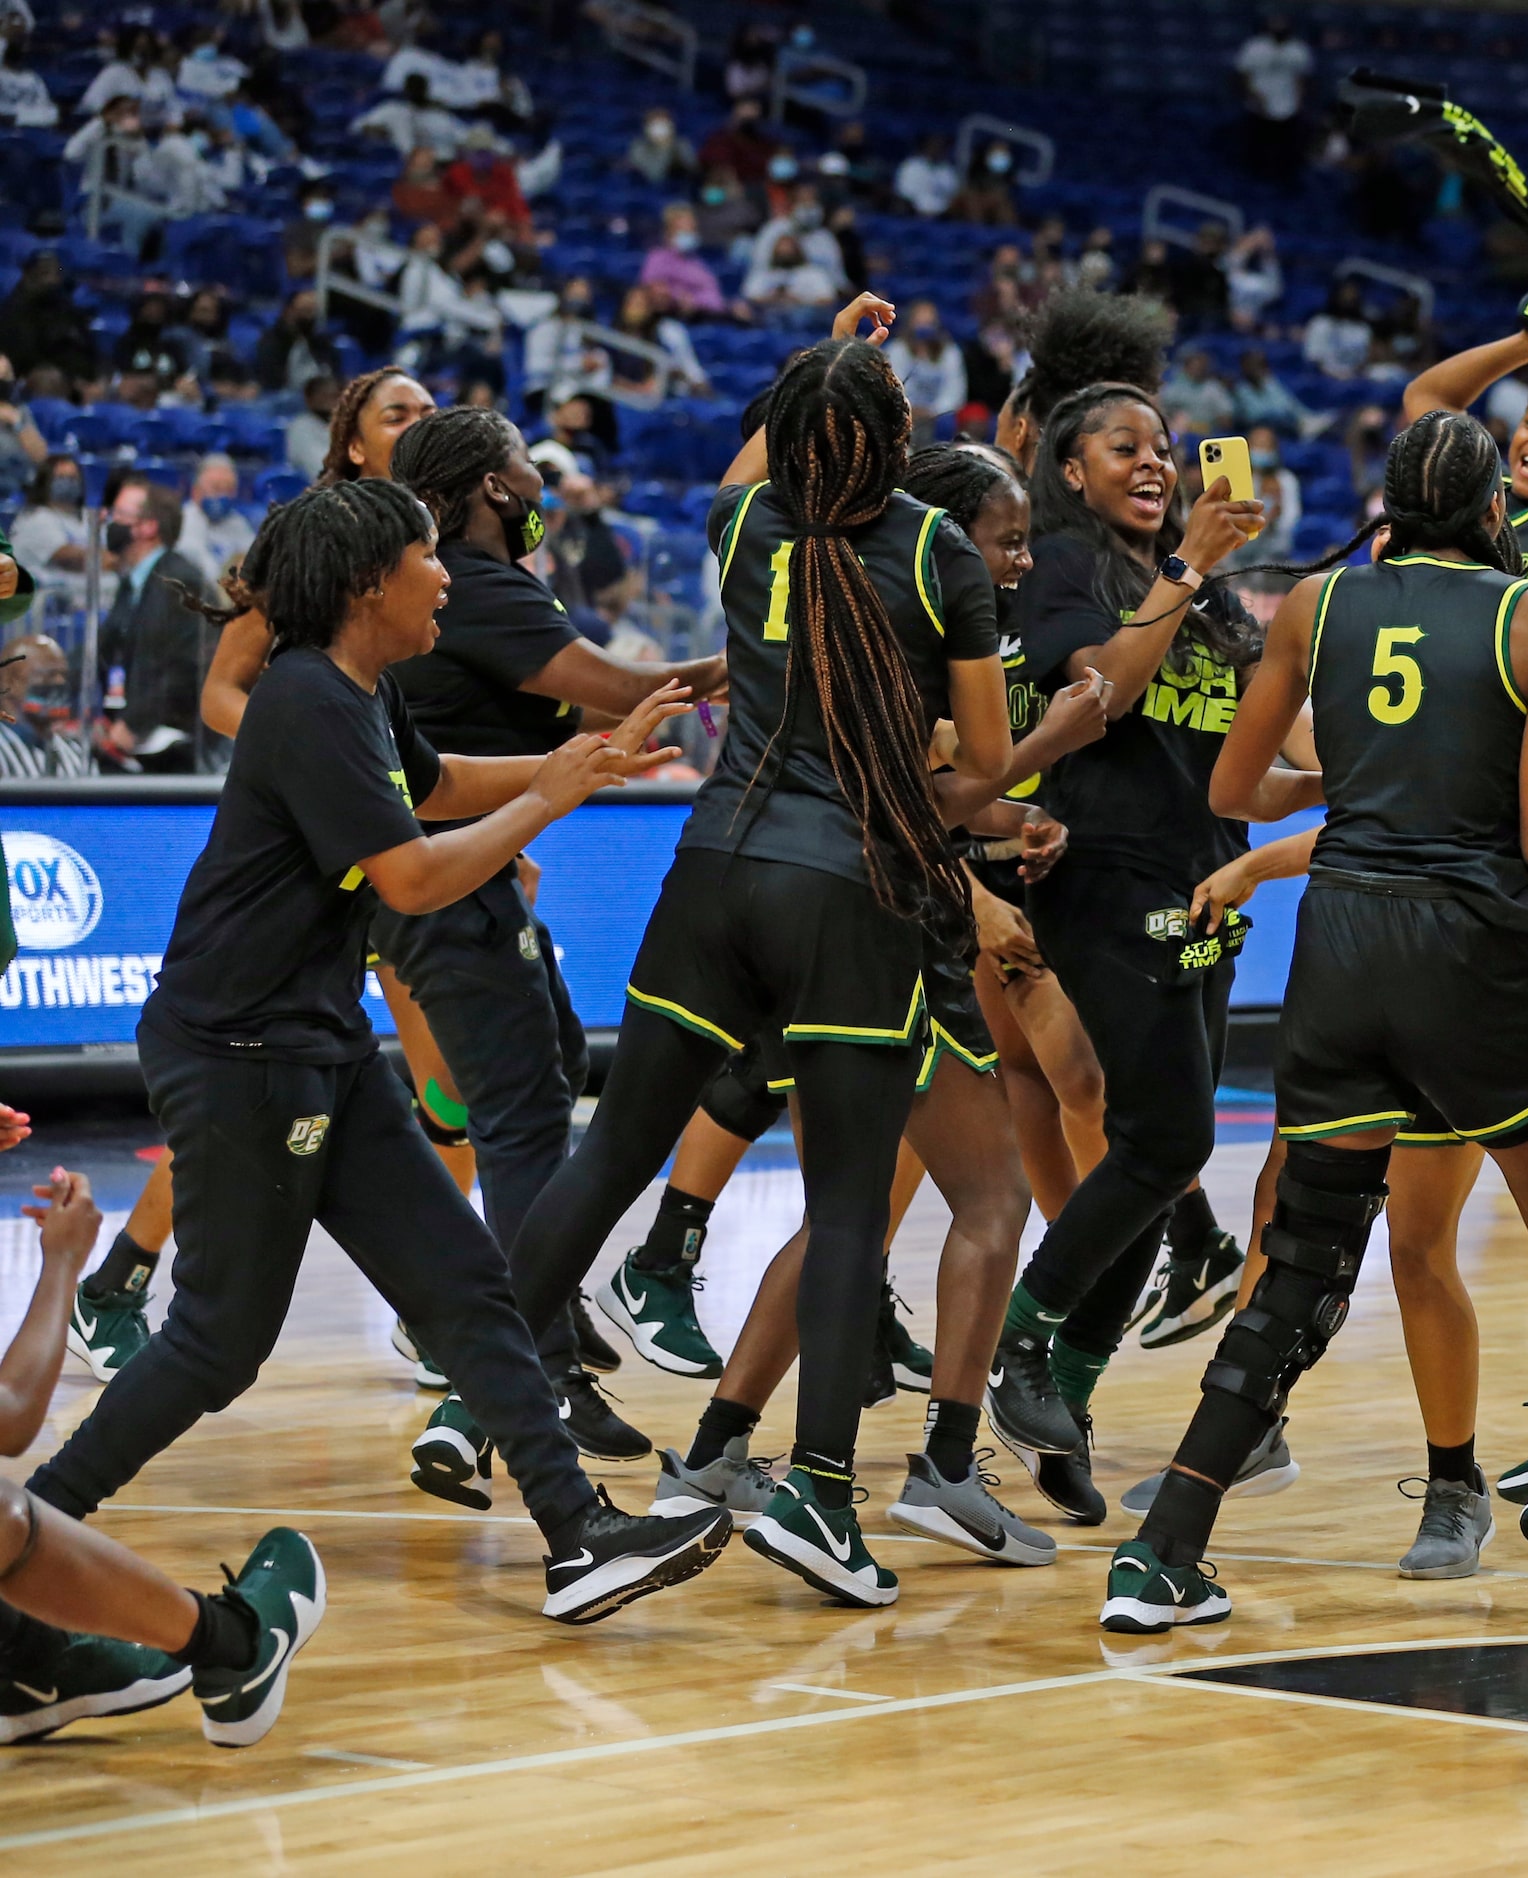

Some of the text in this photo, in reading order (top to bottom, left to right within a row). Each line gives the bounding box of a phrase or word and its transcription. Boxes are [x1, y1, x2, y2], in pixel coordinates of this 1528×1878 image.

[763, 541, 795, 641] 1
[1367, 626, 1427, 725] 5
[1142, 682, 1238, 734] IME
[15, 859, 71, 901] OX
[0, 954, 164, 1009] UTHWEST
[289, 1119, 324, 1152] DE
